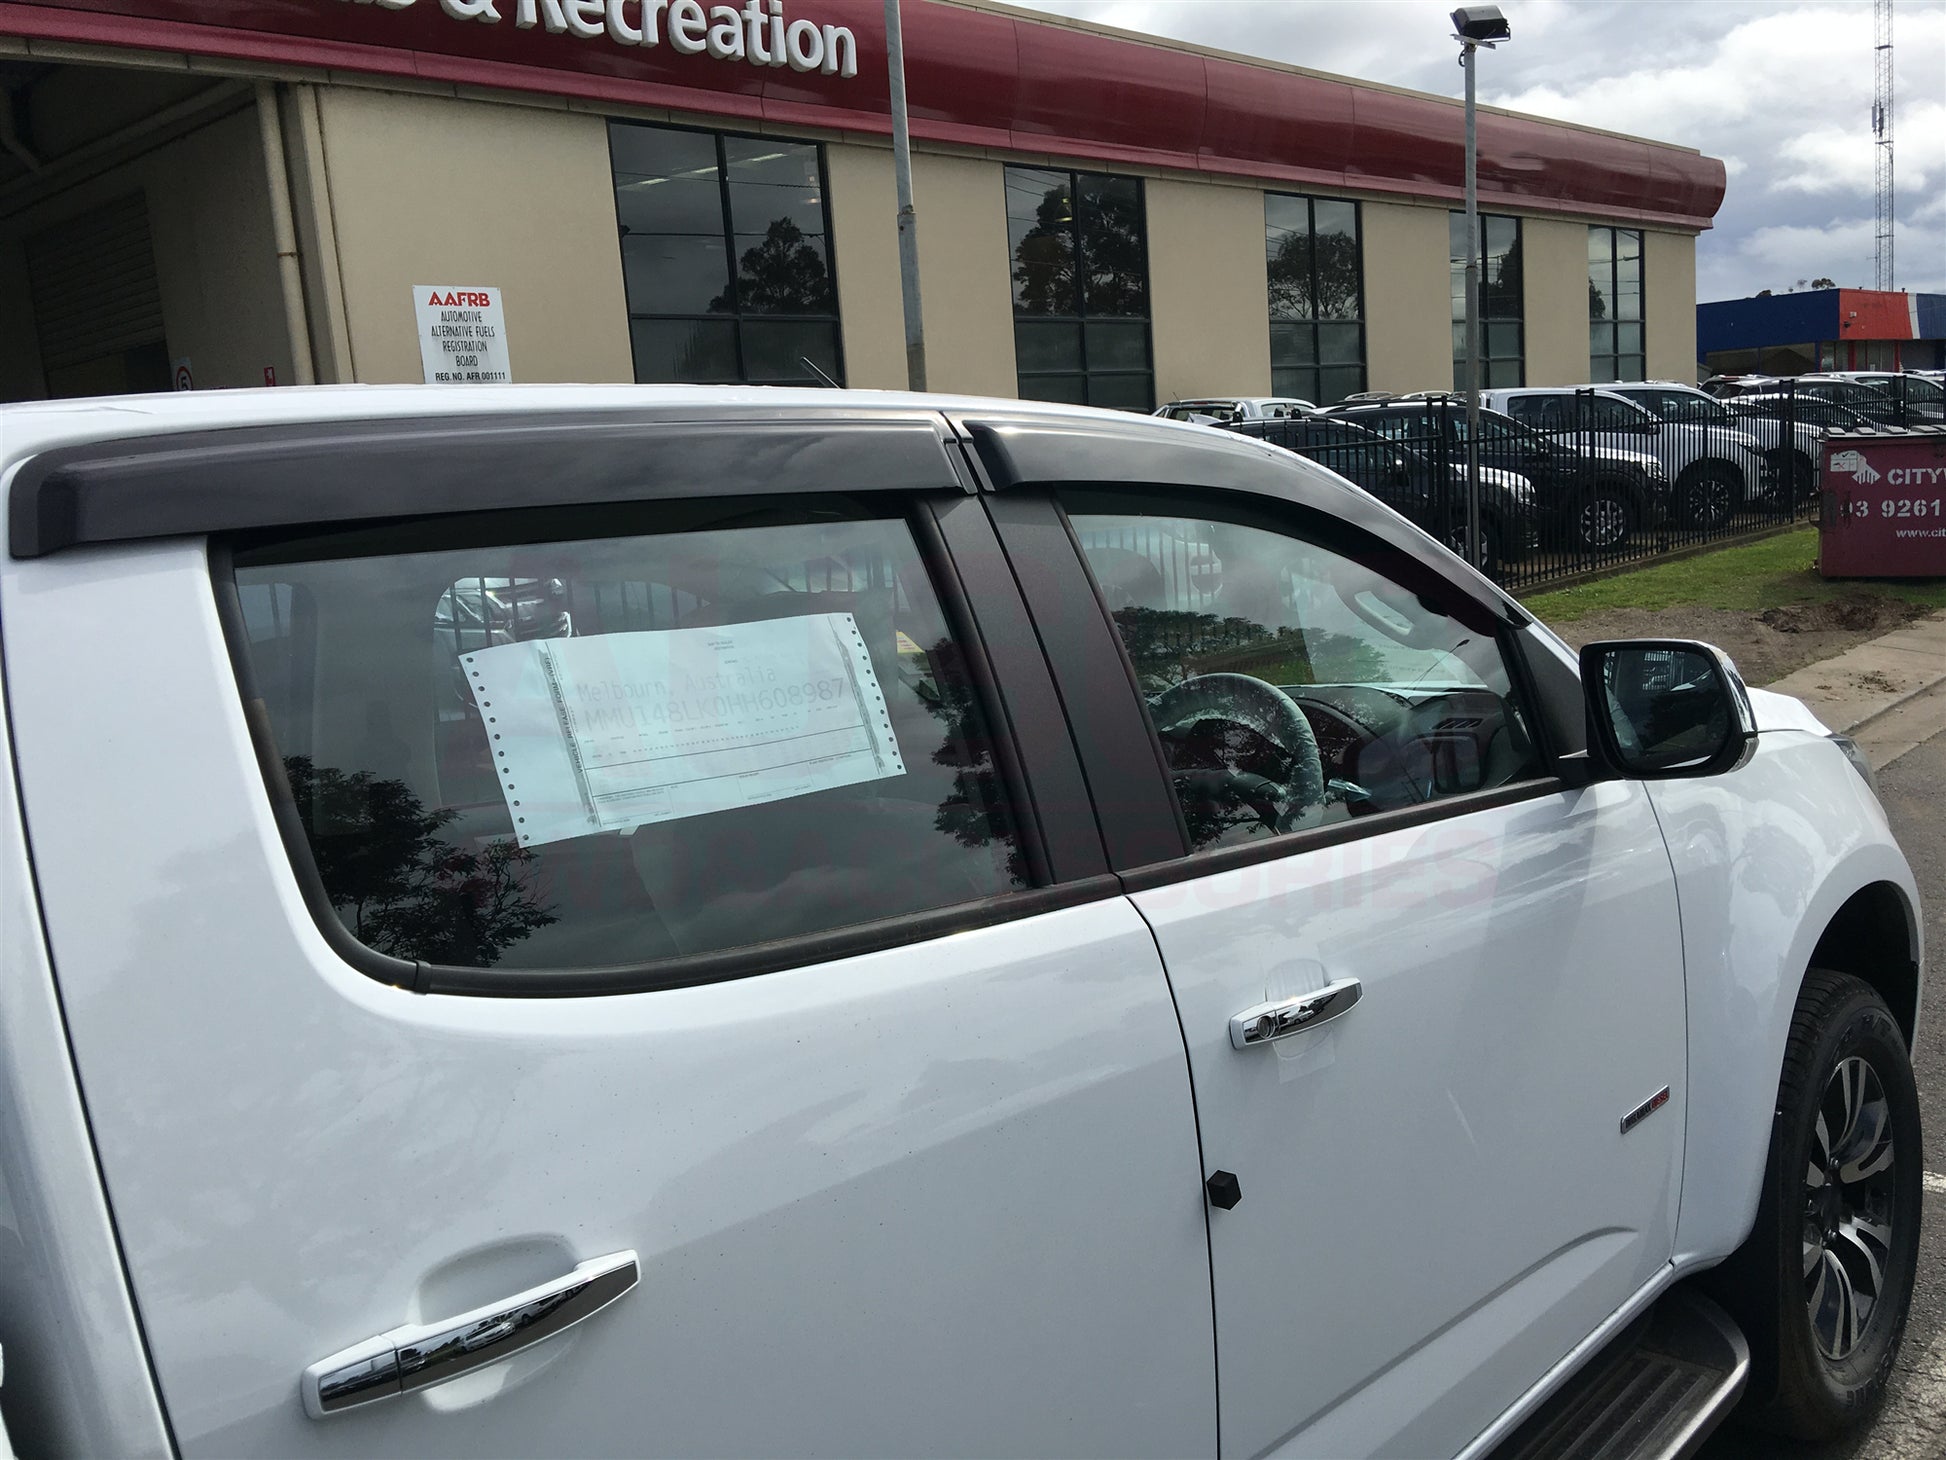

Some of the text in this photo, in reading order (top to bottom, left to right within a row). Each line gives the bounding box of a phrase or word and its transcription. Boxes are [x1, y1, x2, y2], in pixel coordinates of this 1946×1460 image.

[429, 292, 490, 307] AAFRB
[441, 310, 483, 322] AUTOMOTIVE
[431, 325, 496, 337] ALTERNATIVE FUELS
[442, 340, 488, 352] REGISTRATION
[455, 355, 479, 367] BOARD
[466, 372, 480, 381] AFR
[1887, 467, 1946, 485] CITY
[1881, 498, 1941, 518] 9261
[684, 666, 776, 692] Australia
